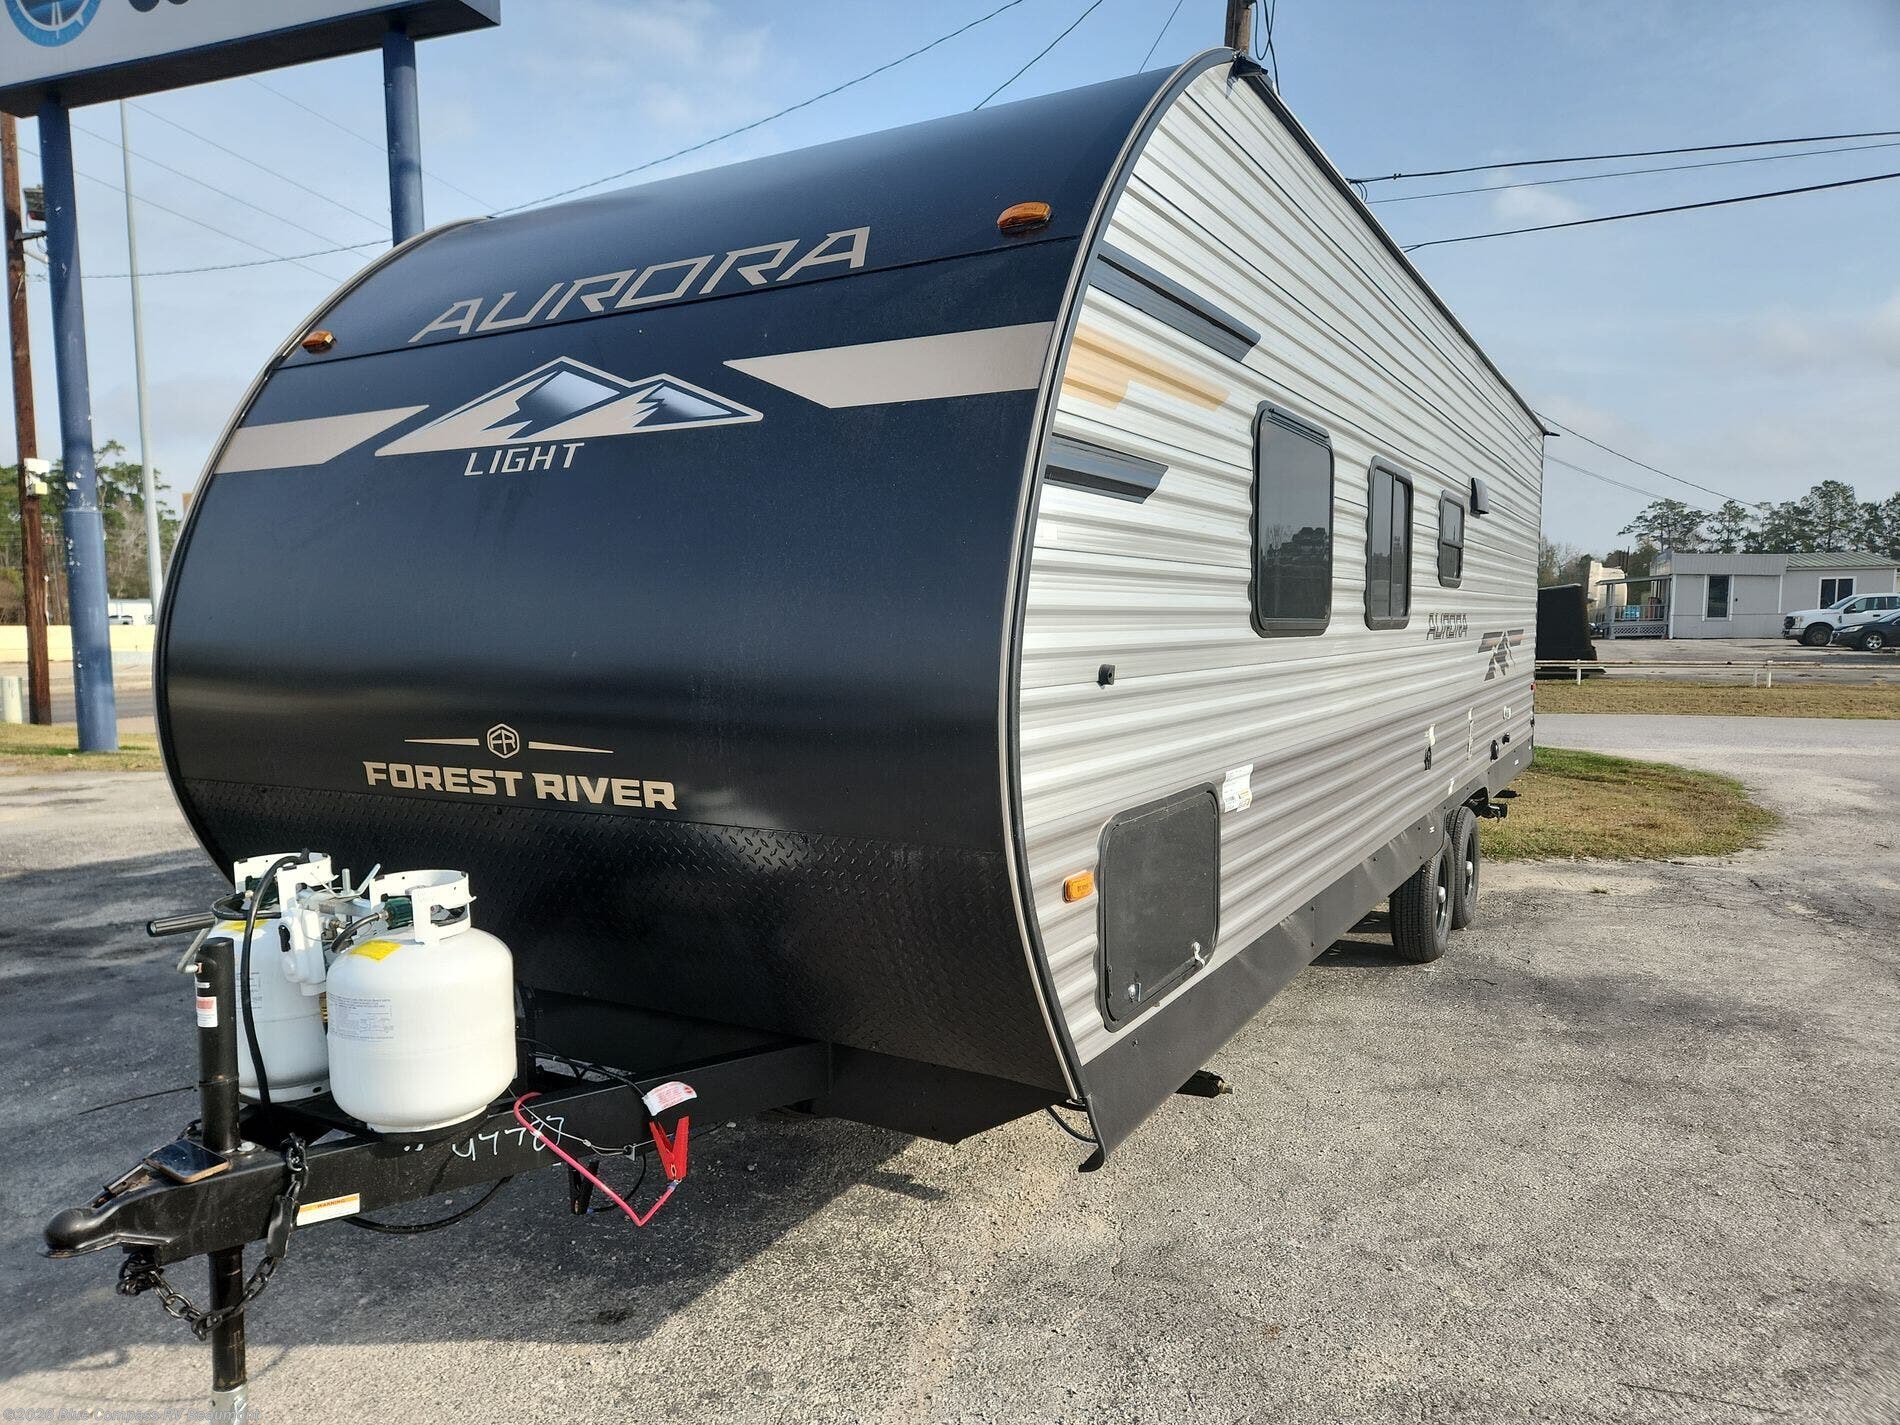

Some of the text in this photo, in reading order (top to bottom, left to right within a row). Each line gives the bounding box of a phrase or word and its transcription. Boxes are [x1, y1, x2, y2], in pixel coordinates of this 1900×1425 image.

[408, 226, 870, 343] AURORA
[465, 443, 585, 476] LIGHT
[362, 761, 677, 810] FOREST RIVER
